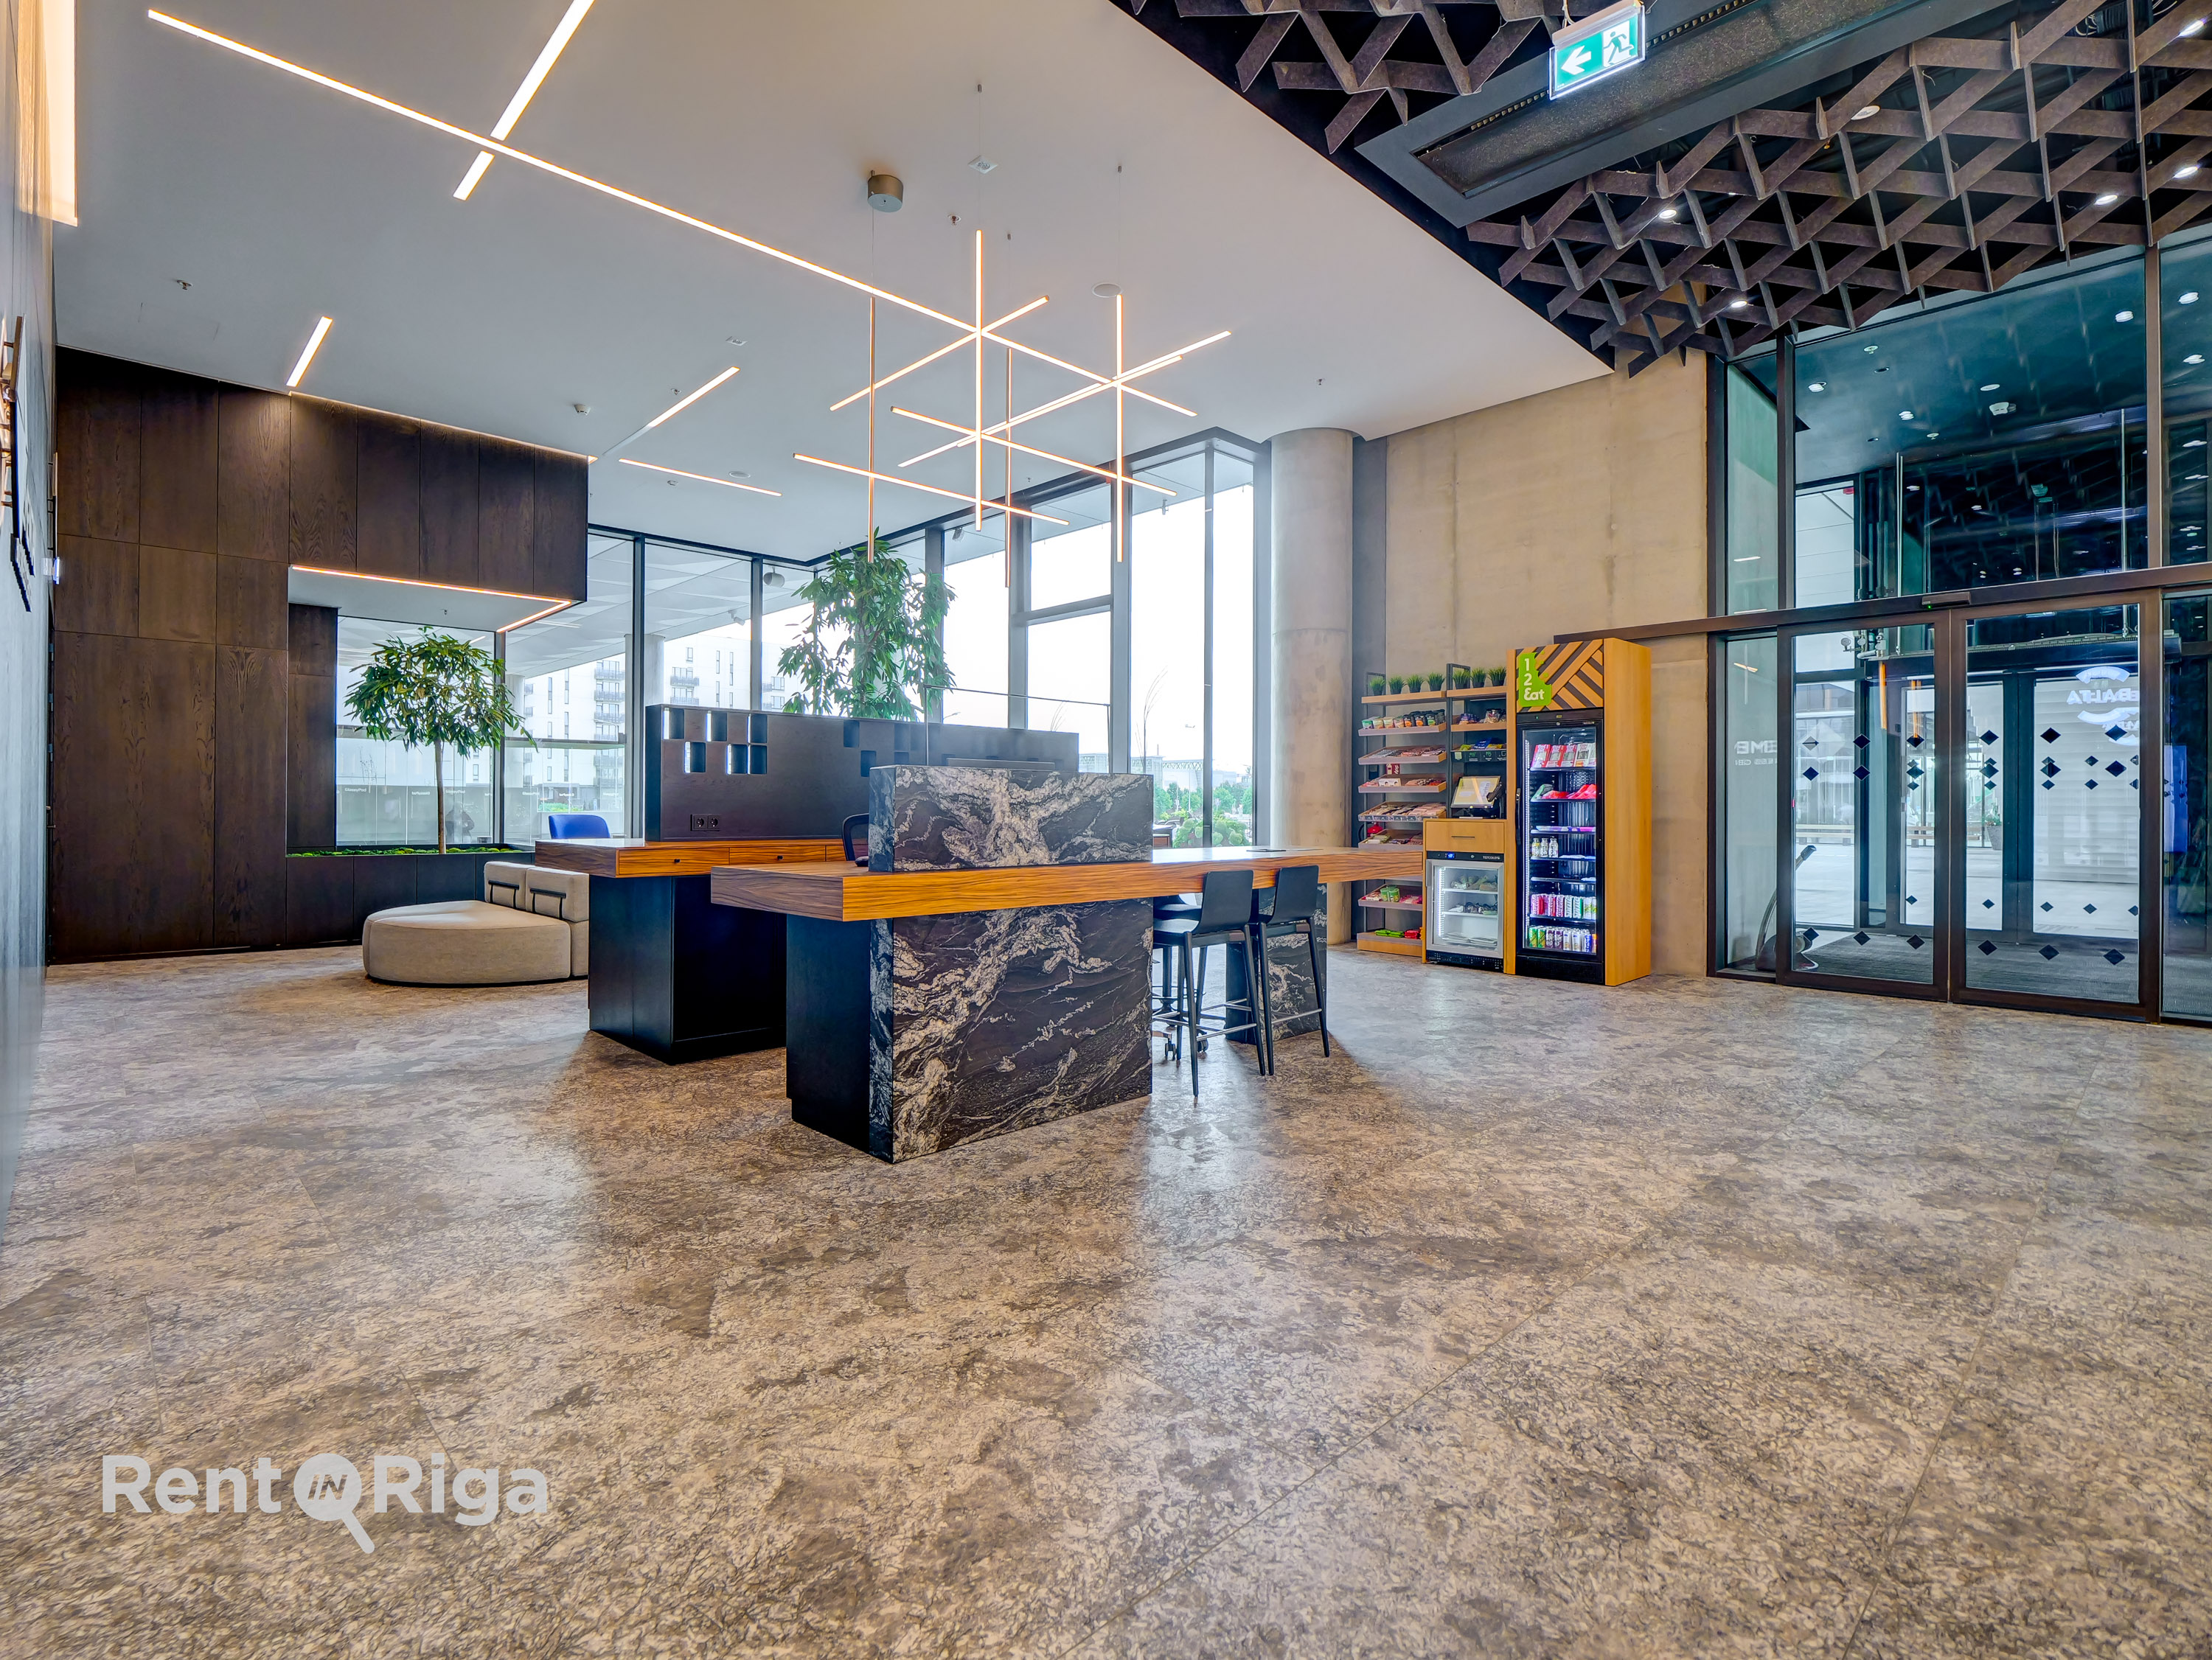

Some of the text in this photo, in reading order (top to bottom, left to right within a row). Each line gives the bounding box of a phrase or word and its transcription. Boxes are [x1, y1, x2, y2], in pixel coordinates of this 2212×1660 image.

[1524, 658, 1530, 672] 1
[1523, 672, 1533, 686] 2
[1523, 687, 1545, 701] Eat
